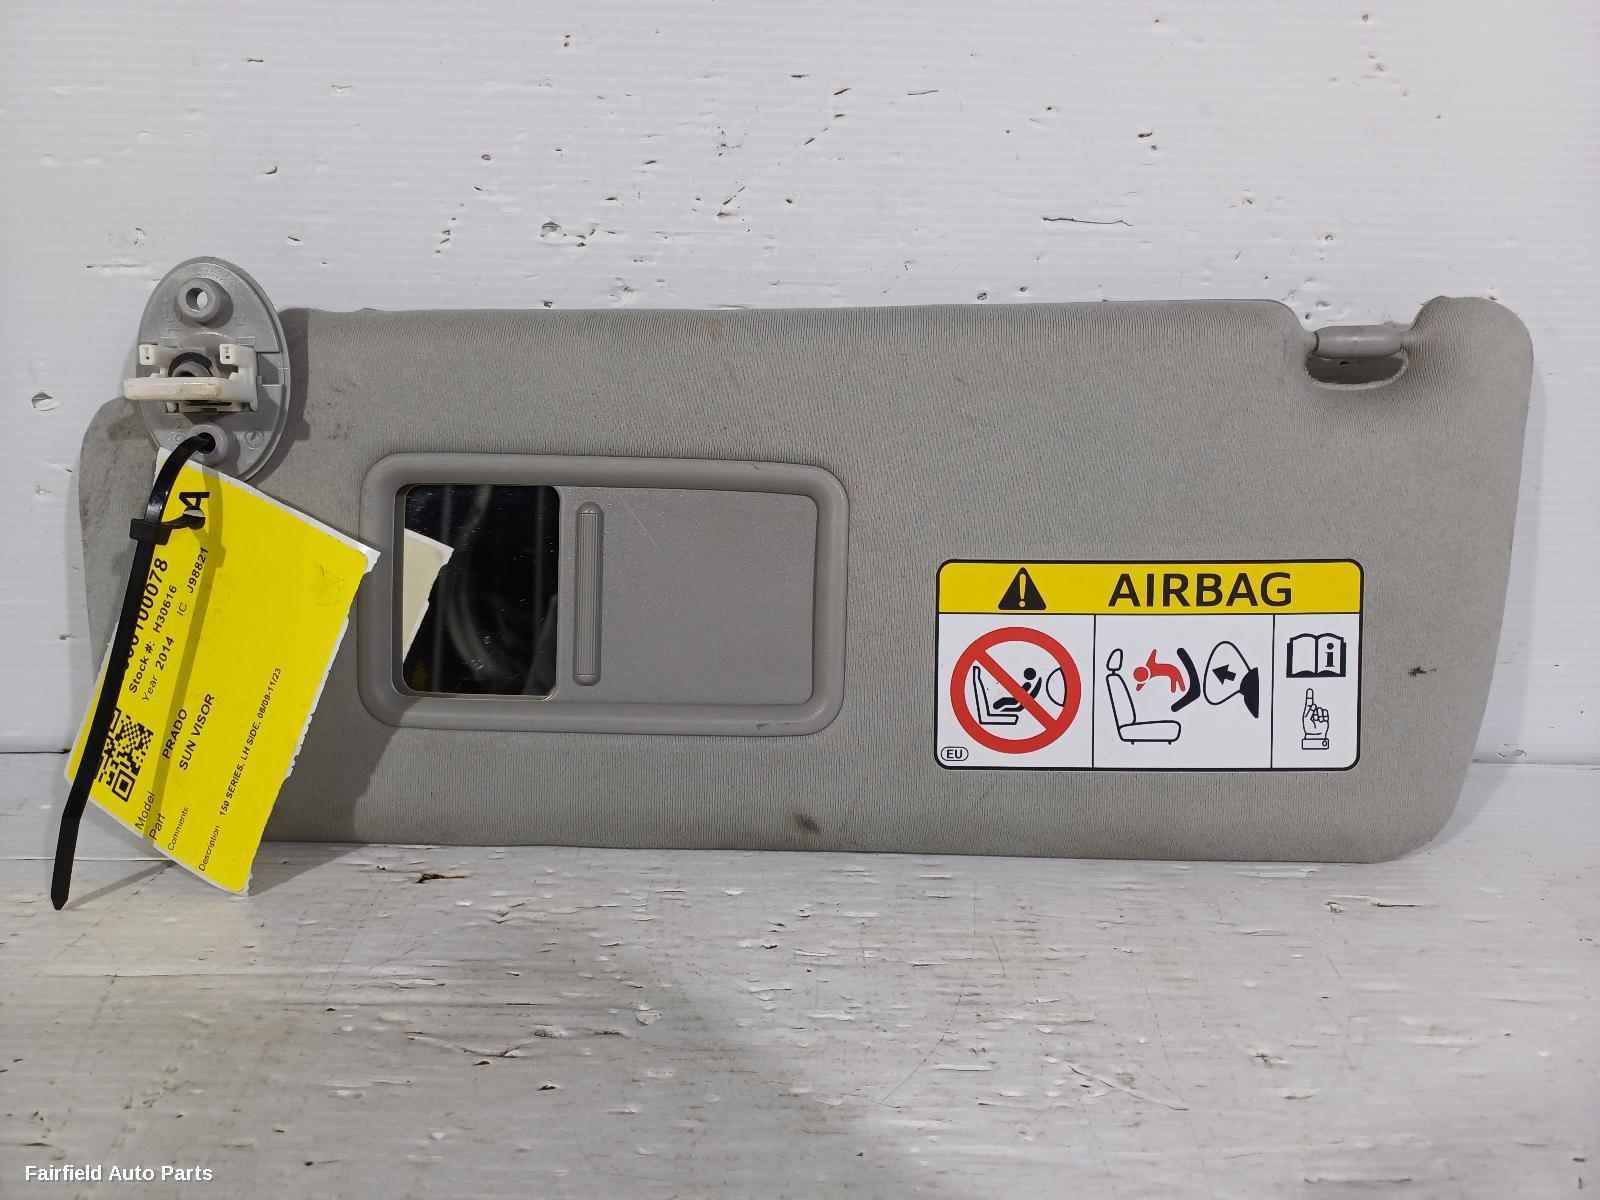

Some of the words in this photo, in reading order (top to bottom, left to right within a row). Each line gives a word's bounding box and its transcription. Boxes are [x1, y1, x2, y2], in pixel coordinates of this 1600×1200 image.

[128, 656, 150, 693] Stock
[153, 584, 177, 633] H30616
[142, 675, 158, 701] Year
[155, 636, 174, 670] 2014
[177, 602, 187, 616] IC
[187, 547, 208, 594] J98821
[1107, 571, 1293, 608] AIRBAG
[134, 790, 156, 830] Model
[161, 708, 188, 759] PRADO
[149, 813, 166, 841] Part
[179, 740, 197, 771] SUN
[191, 693, 215, 737] VISOR
[198, 825, 220, 872] Description
[219, 800, 230, 817] 150
[240, 747, 250, 761] LH
[257, 667, 282, 719] 08/09-11/23
[946, 748, 963, 760] EU
[167, 806, 190, 851] Comments
